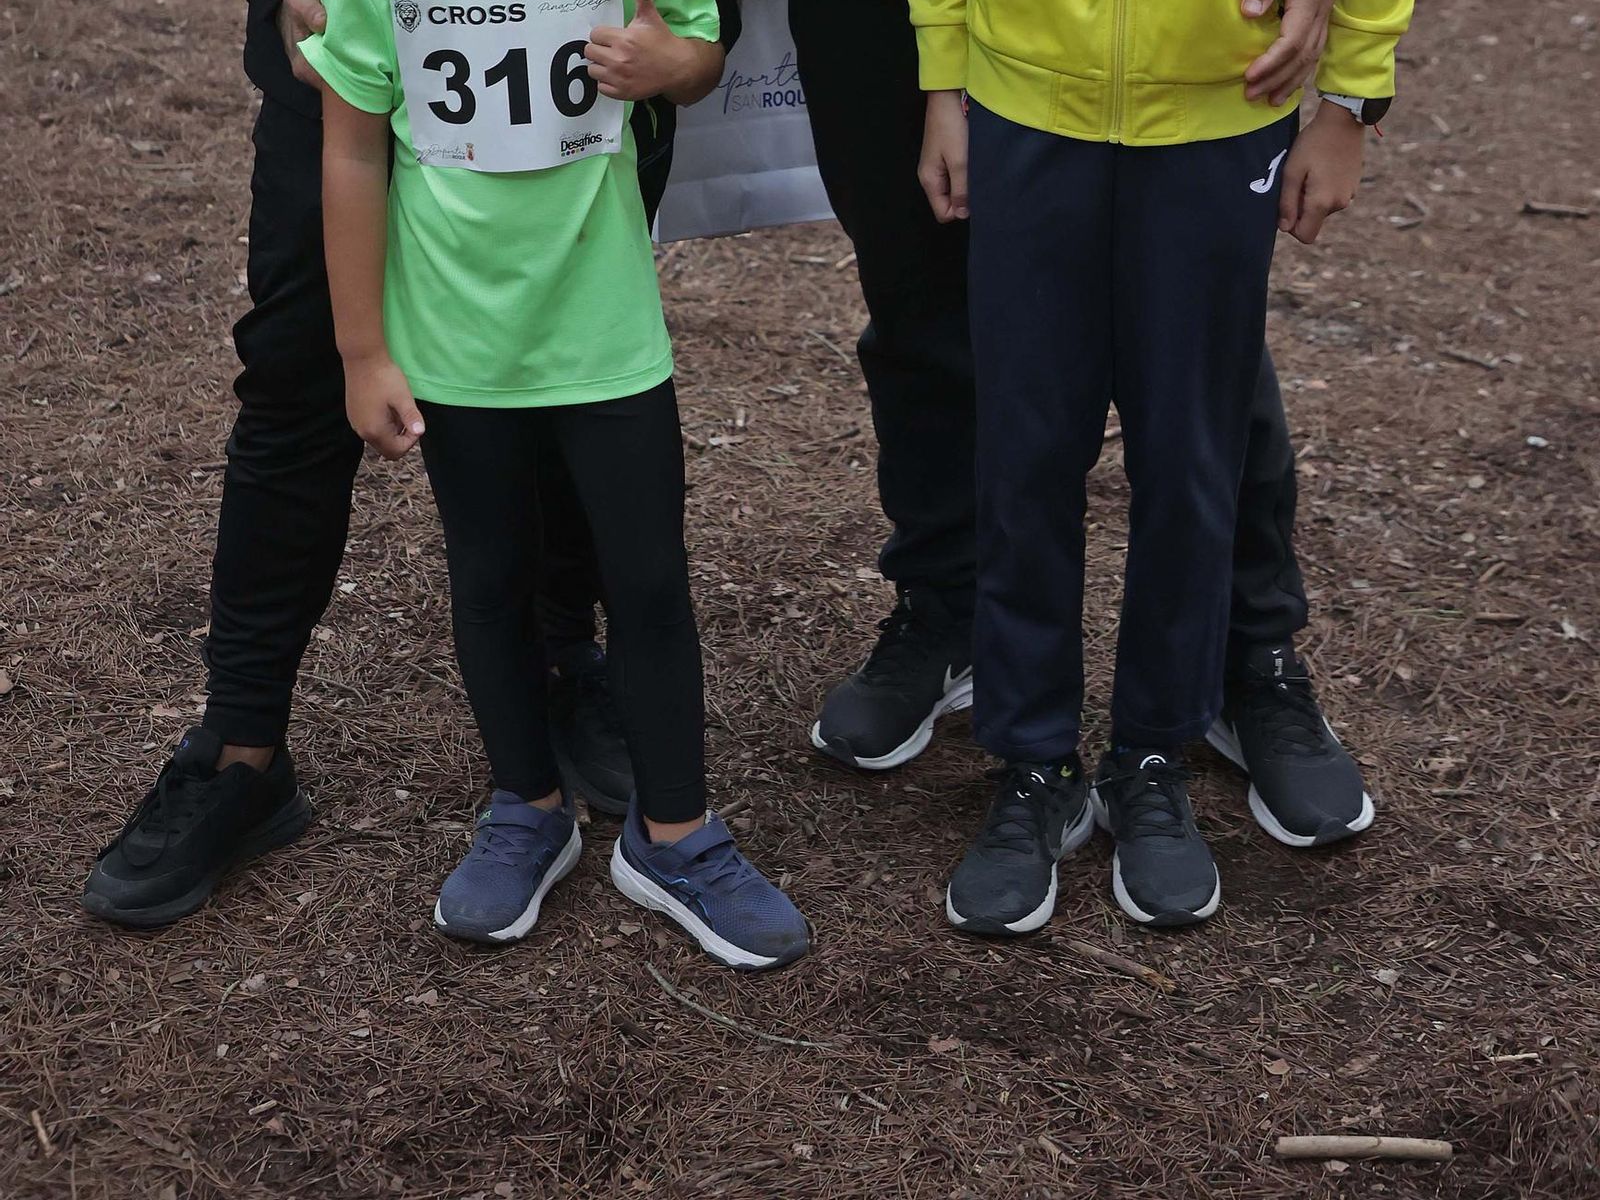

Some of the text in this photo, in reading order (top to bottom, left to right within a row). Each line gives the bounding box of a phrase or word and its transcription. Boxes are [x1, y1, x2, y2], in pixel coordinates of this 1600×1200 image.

[428, 3, 526, 26] CROSS
[422, 39, 599, 125] 316
[560, 133, 603, 152] Desafíos
